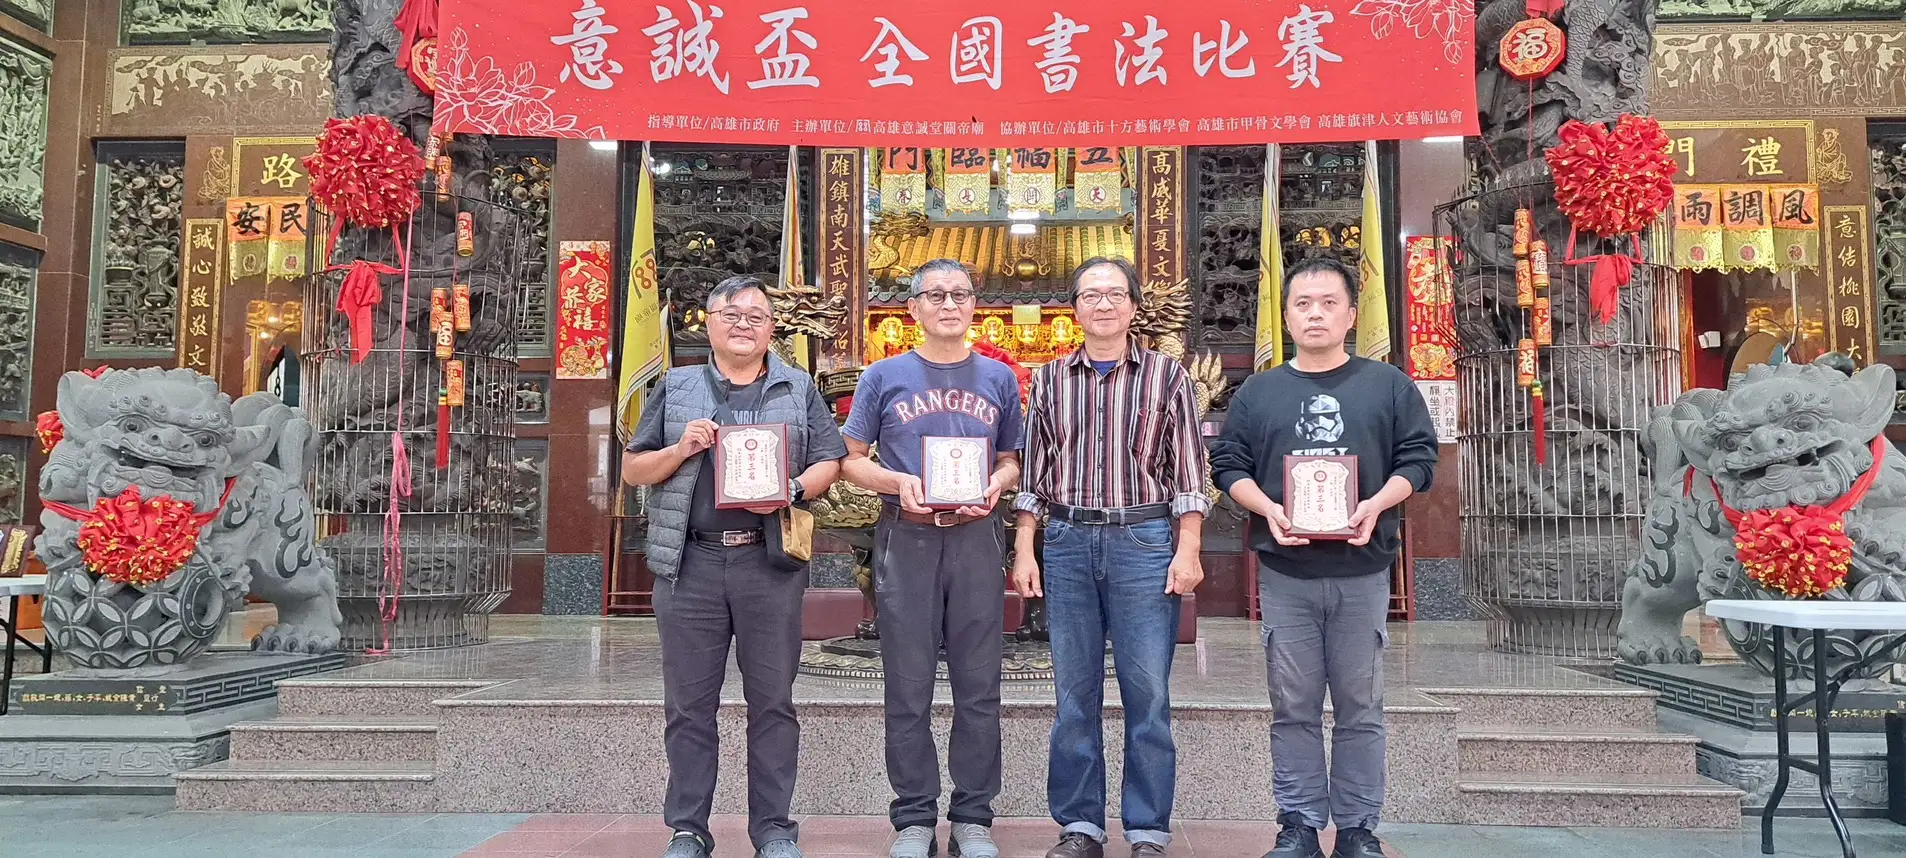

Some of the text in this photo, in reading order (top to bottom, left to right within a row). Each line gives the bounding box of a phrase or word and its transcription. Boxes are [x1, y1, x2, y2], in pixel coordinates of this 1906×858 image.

[1511, 28, 1548, 60] 福
[647, 114, 780, 133] 指導單位/高雄市政府
[1197, 115, 1312, 132] 高雄市甲骨文學會
[261, 152, 302, 189] 路
[1834, 214, 1863, 375] 意結桃園大
[893, 387, 998, 425] RANGERS
